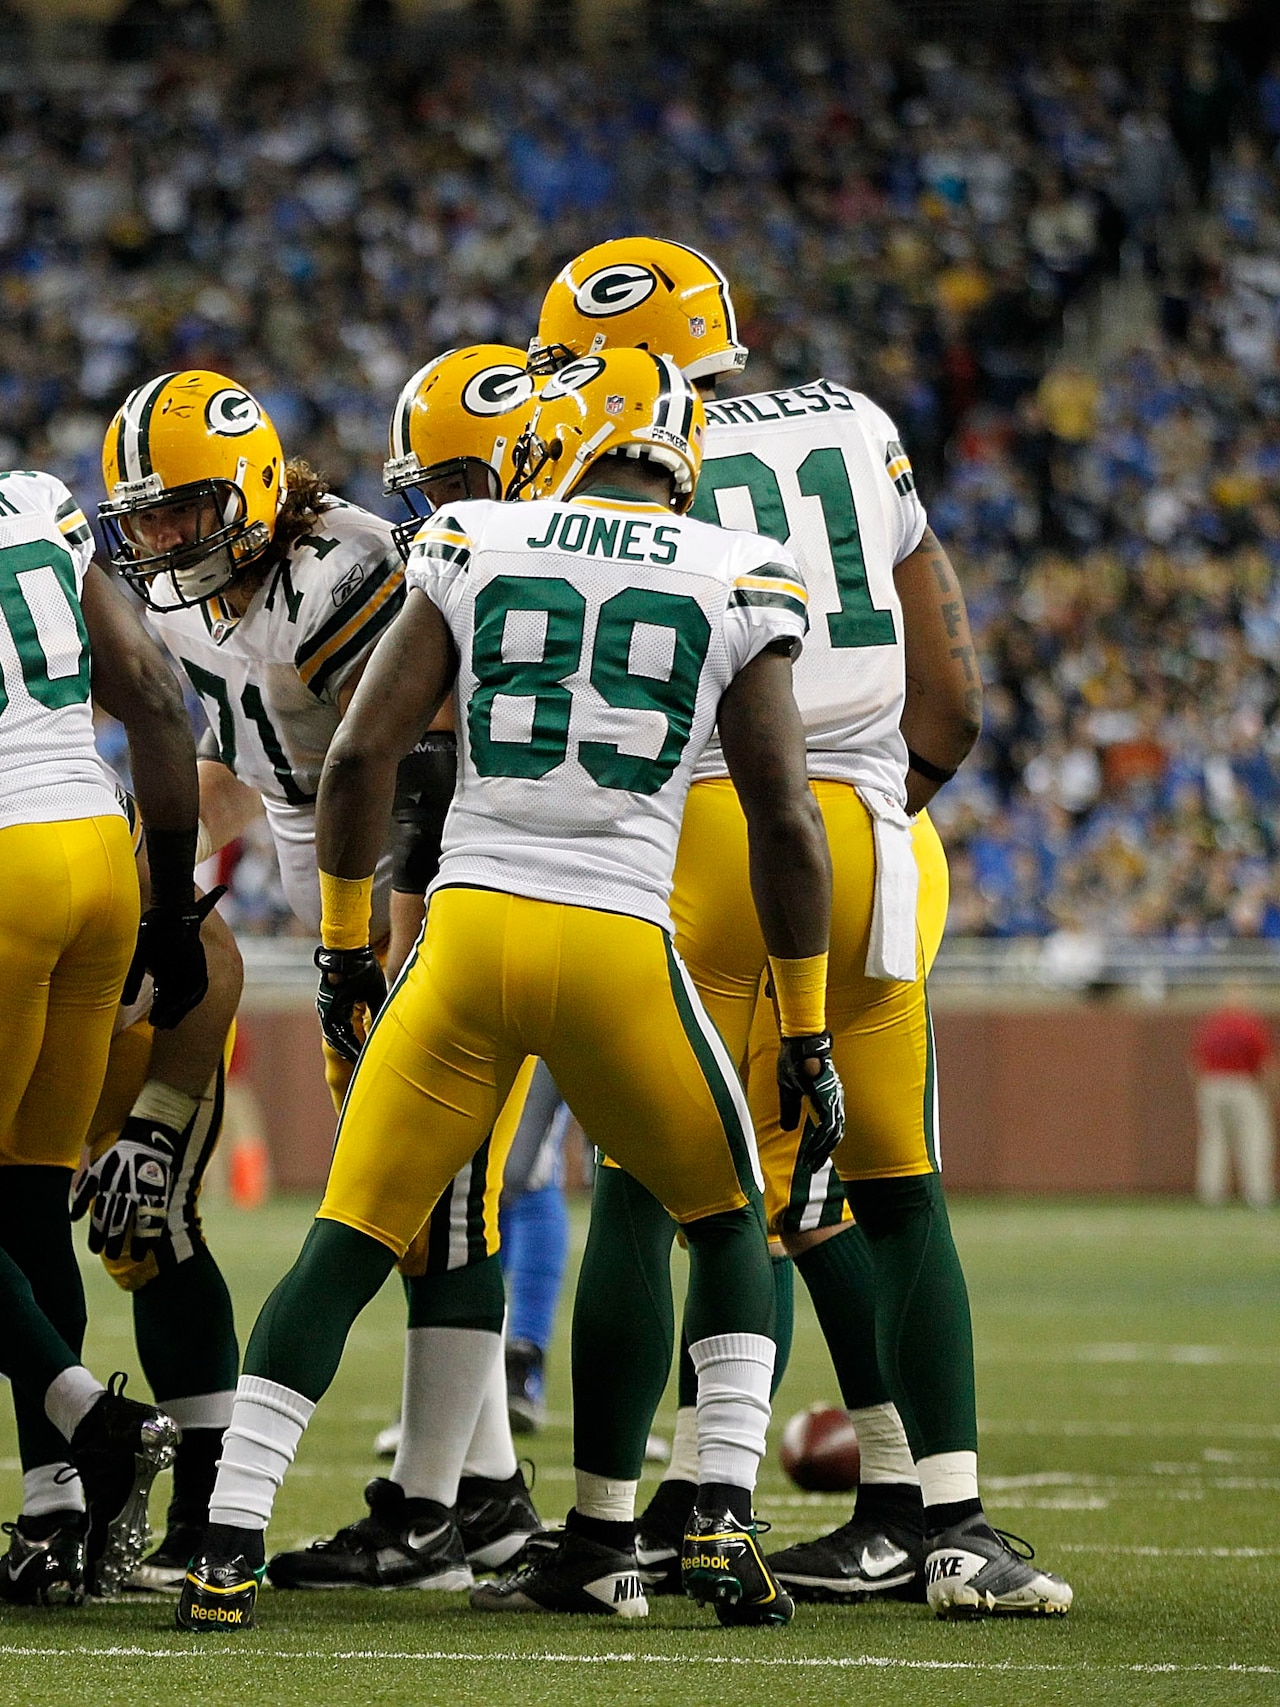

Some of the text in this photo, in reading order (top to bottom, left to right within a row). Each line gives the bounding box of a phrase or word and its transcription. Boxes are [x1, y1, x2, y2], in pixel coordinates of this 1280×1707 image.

[527, 512, 681, 565] JONES
[179, 656, 317, 806] 71
[466, 574, 712, 796] 89
[191, 1604, 243, 1624] Reebok
